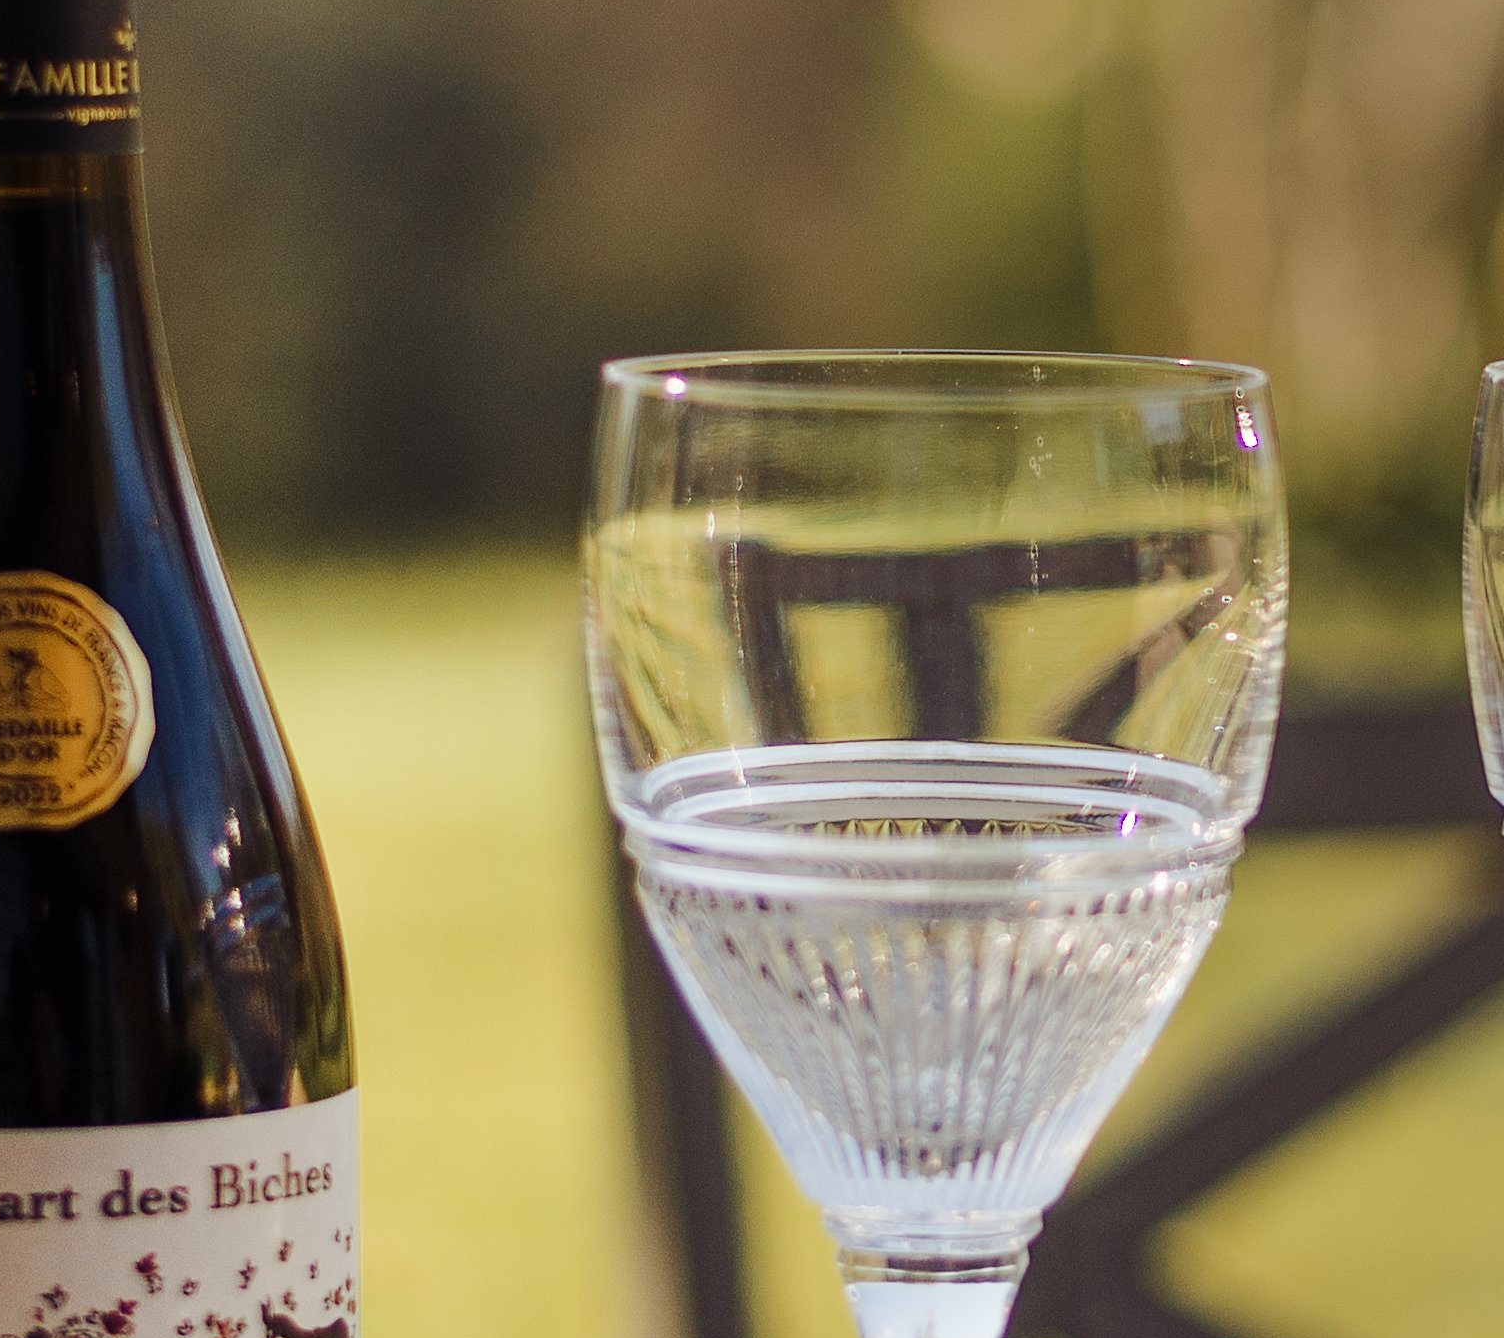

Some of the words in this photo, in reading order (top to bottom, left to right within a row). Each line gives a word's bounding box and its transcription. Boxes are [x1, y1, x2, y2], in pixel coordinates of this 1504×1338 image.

[17, 602, 58, 621] VINS
[98, 1169, 190, 1219] des
[209, 1152, 333, 1210] Biches
